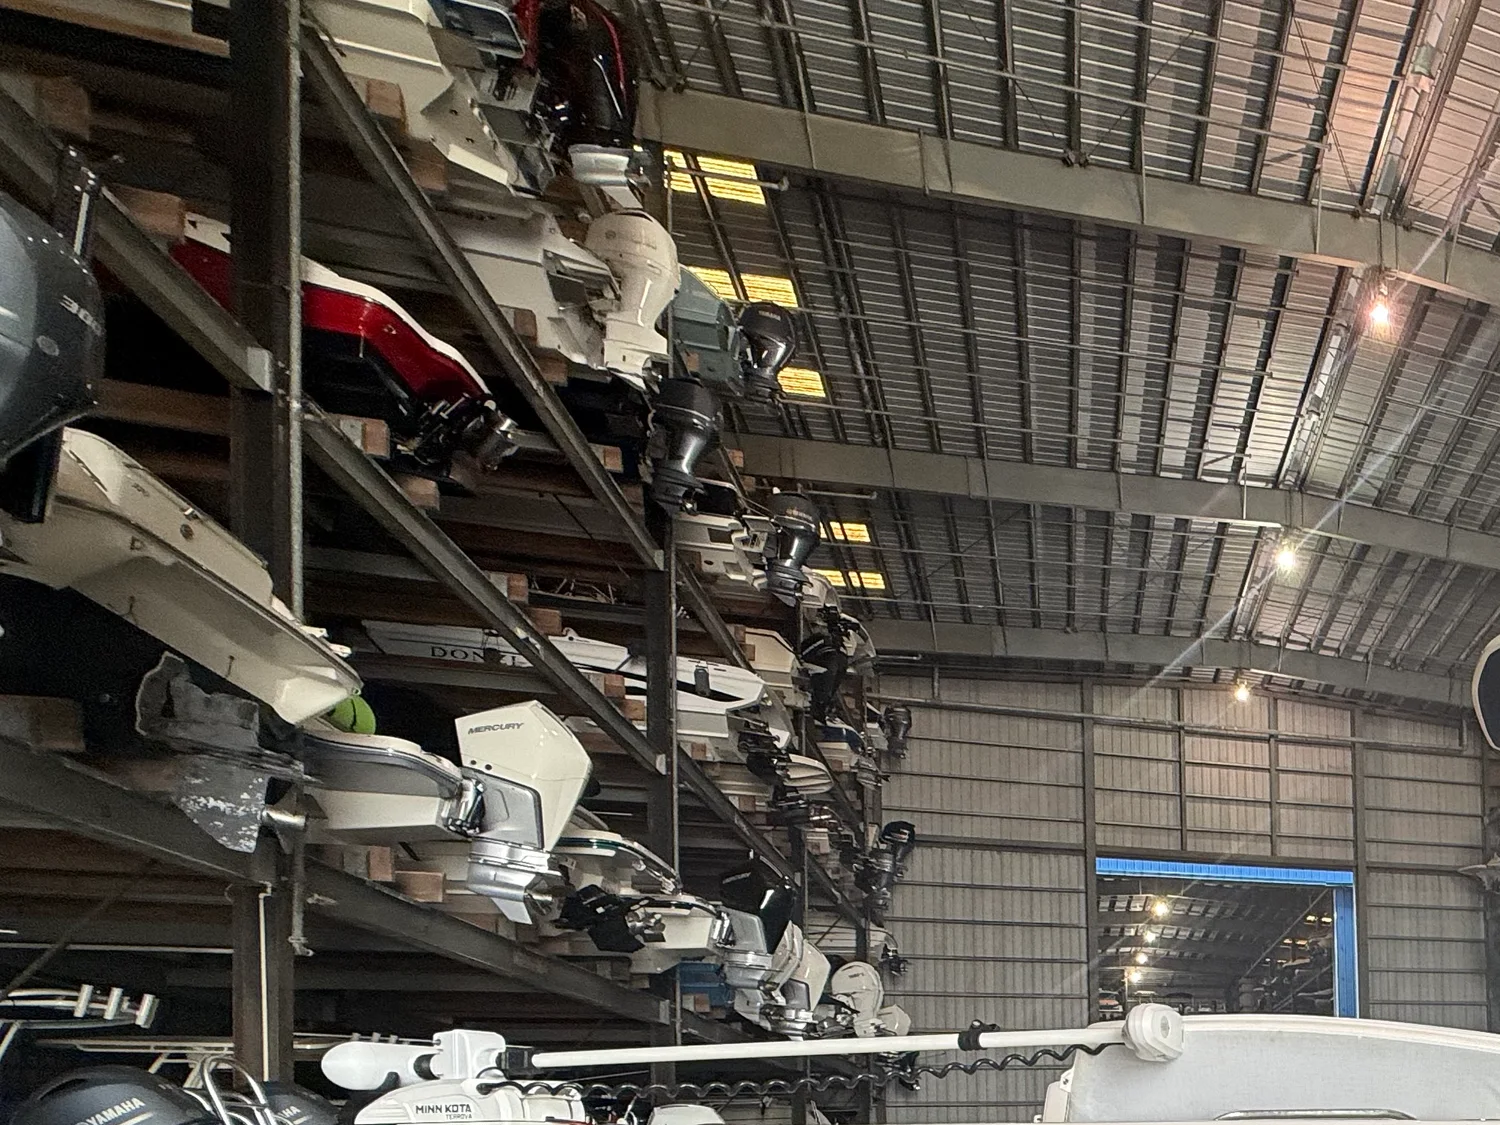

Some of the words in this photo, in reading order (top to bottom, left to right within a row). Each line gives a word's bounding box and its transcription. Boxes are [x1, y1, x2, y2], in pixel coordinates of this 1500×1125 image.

[431, 646, 516, 667] DONI
[468, 722, 524, 735] MERCURY
[415, 1104, 443, 1114] MINN
[445, 1104, 472, 1113] KOTA
